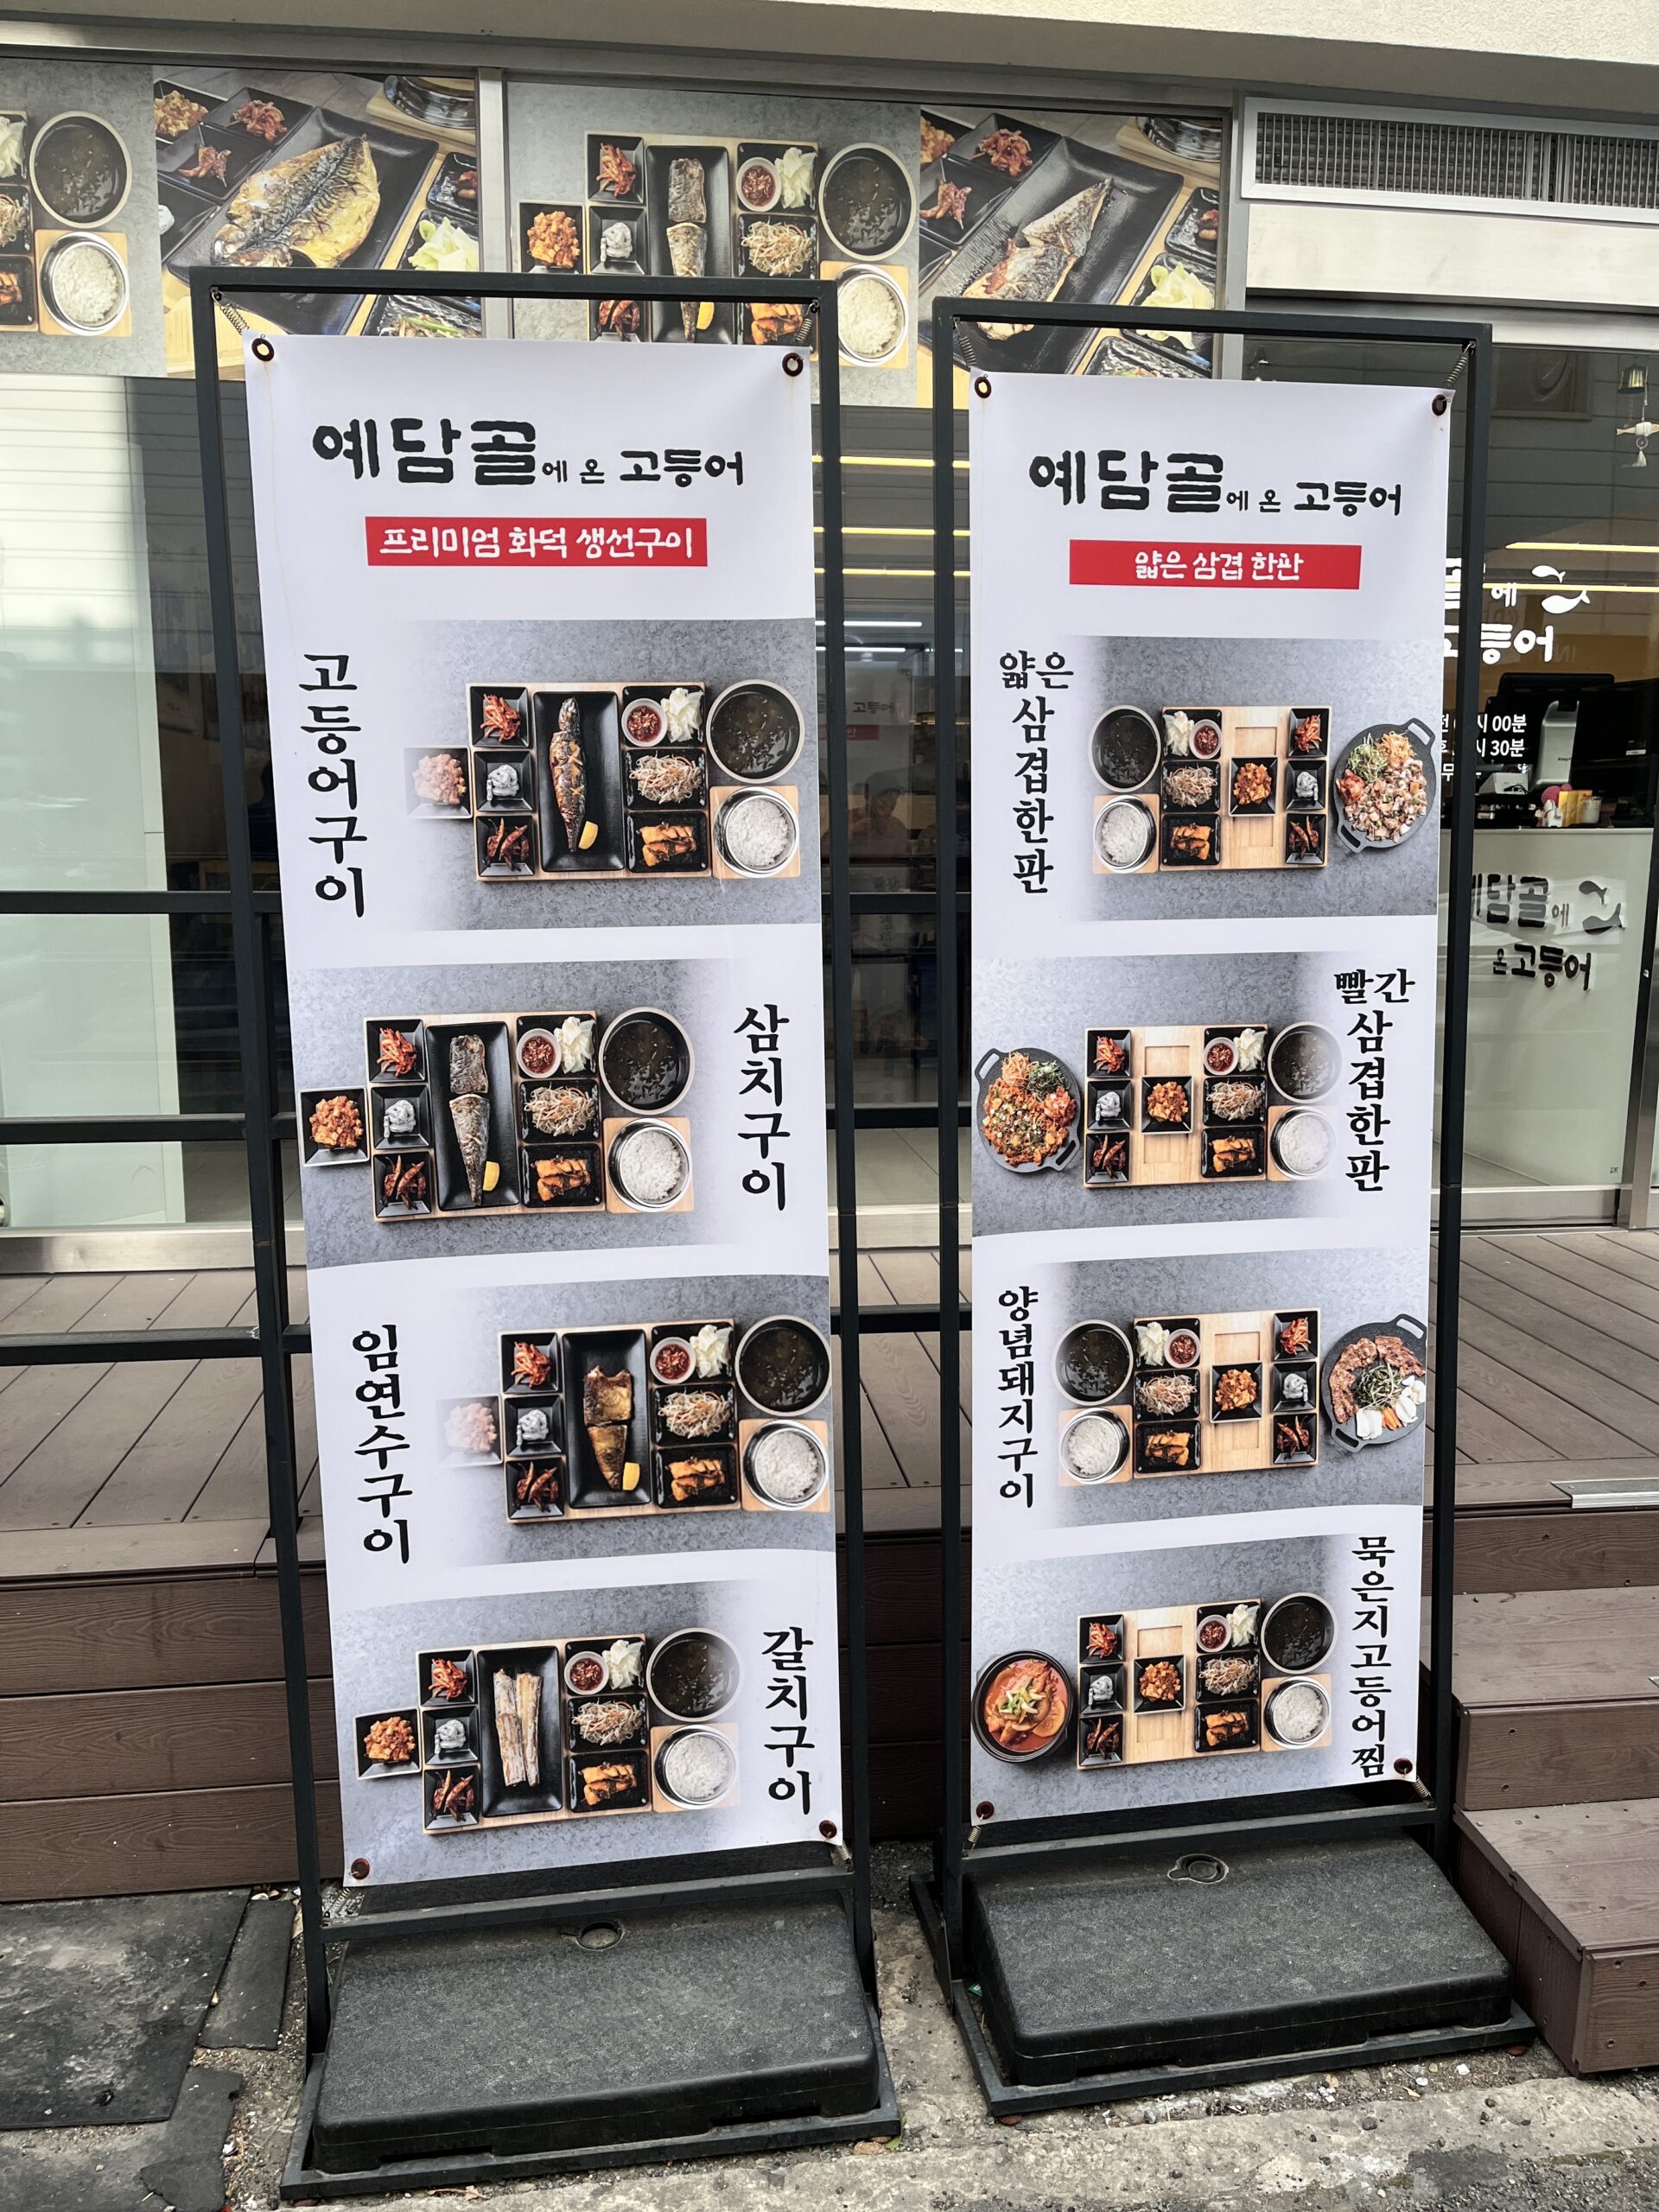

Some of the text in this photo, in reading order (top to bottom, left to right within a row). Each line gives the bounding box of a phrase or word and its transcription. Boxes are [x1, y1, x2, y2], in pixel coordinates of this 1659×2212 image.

[579, 459, 606, 484] 온
[620, 449, 744, 487] 고등어
[1258, 489, 1281, 513] 온
[1294, 480, 1402, 517] 고등어
[379, 527, 692, 560] 프리미엄 화덕 생선구이
[1135, 550, 1304, 581] 얇은 삼겹 한판
[999, 650, 1074, 690] 얇은
[1492, 714, 1527, 733] 00분
[1490, 738, 1525, 758] 30분
[298, 653, 368, 918] 고등어구이
[1333, 968, 1416, 1004] 빨간
[734, 1004, 791, 1211] 삼치구이
[997, 1286, 1039, 1509] 양념돼지구이
[352, 1324, 413, 1564] 임연수구이
[1349, 1536, 1395, 1778] 묵은지고등어찜
[761, 1626, 816, 1815] 갈치구이
